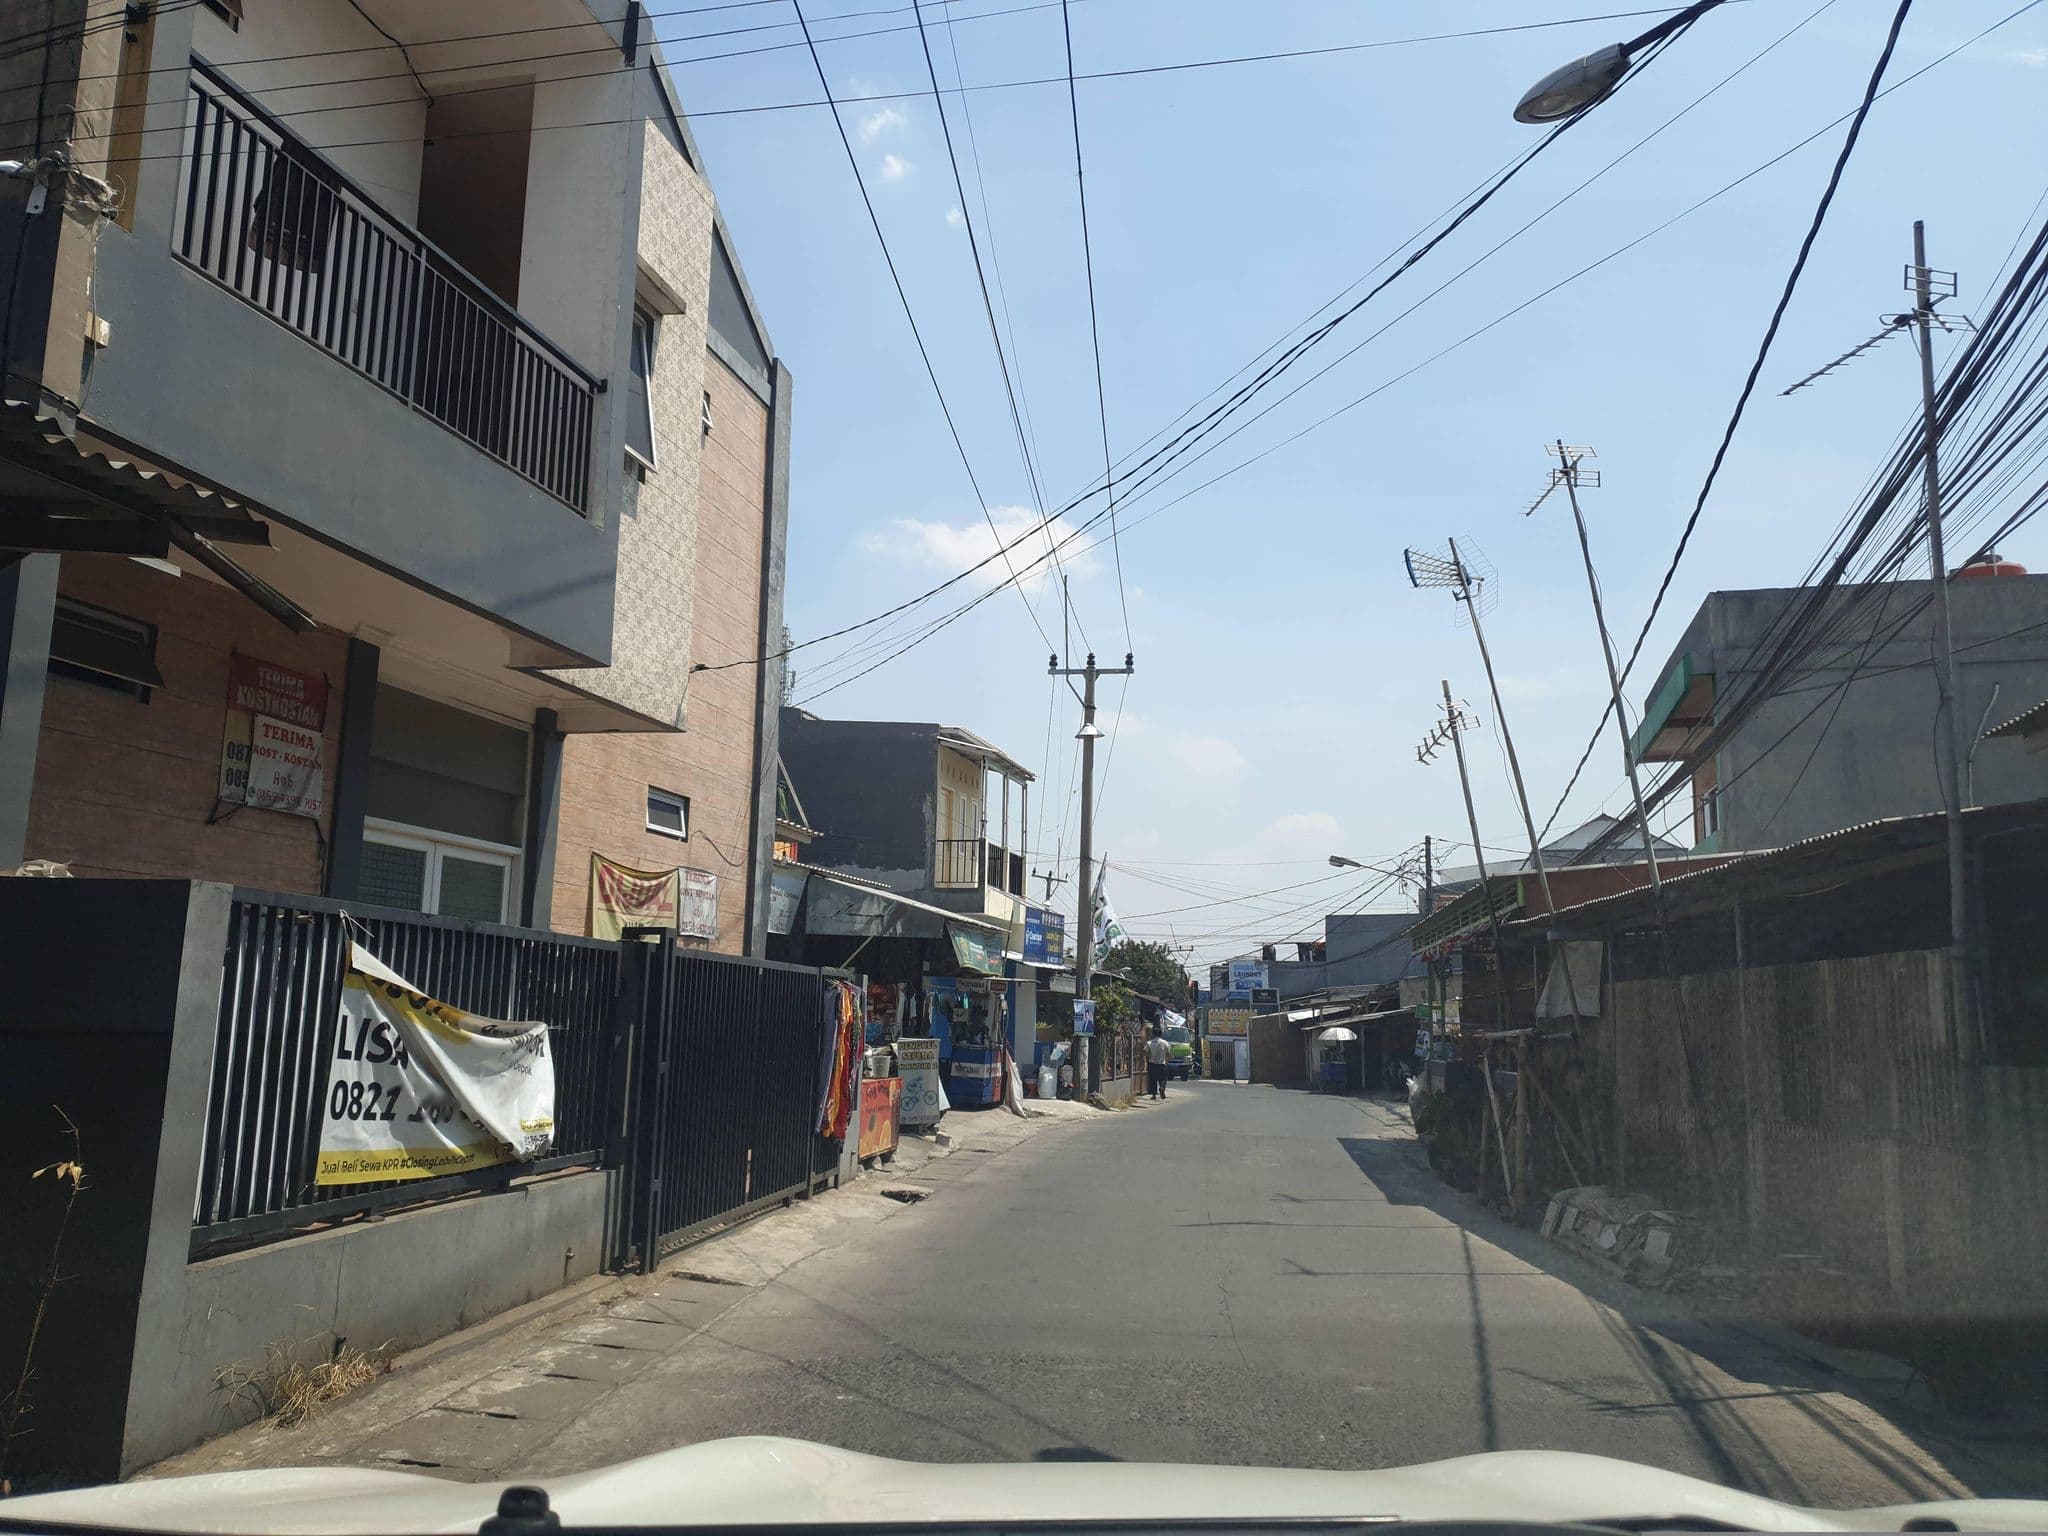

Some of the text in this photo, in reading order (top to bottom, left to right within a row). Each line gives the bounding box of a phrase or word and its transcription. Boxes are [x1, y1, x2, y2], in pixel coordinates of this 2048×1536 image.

[263, 723, 315, 750] TERIMA
[330, 1079, 402, 1121] 0821
[321, 1161, 340, 1174] Jual
[341, 1159, 359, 1173] Beli
[360, 1160, 381, 1172] Sewa
[382, 1158, 400, 1171] KPR
